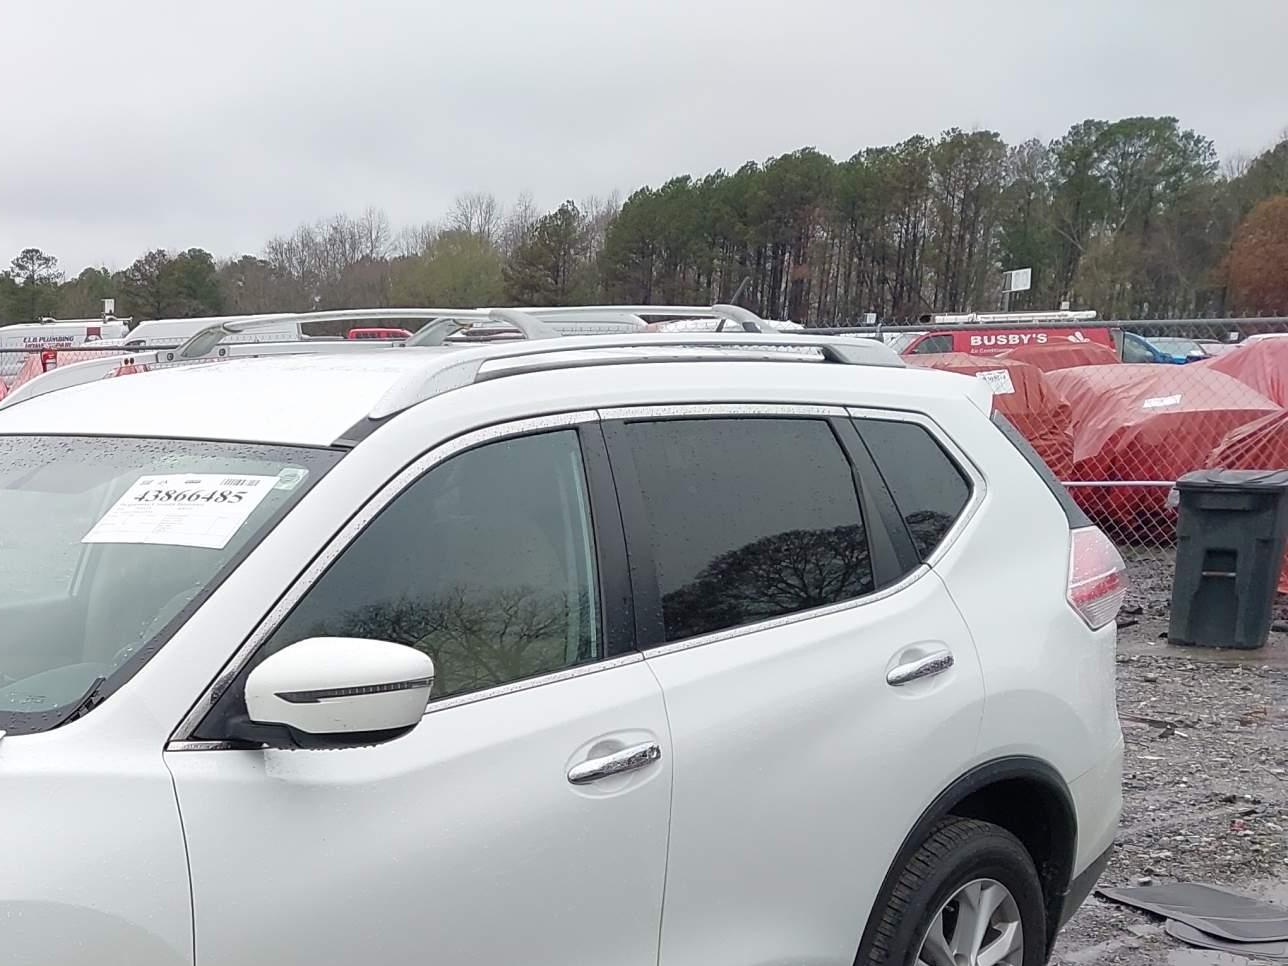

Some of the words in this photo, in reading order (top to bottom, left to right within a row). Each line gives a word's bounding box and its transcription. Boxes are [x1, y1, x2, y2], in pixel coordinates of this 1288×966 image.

[39, 335, 74, 343] PLUMBING
[970, 333, 1048, 346] BUSBY'S
[133, 489, 249, 504] 43866485
